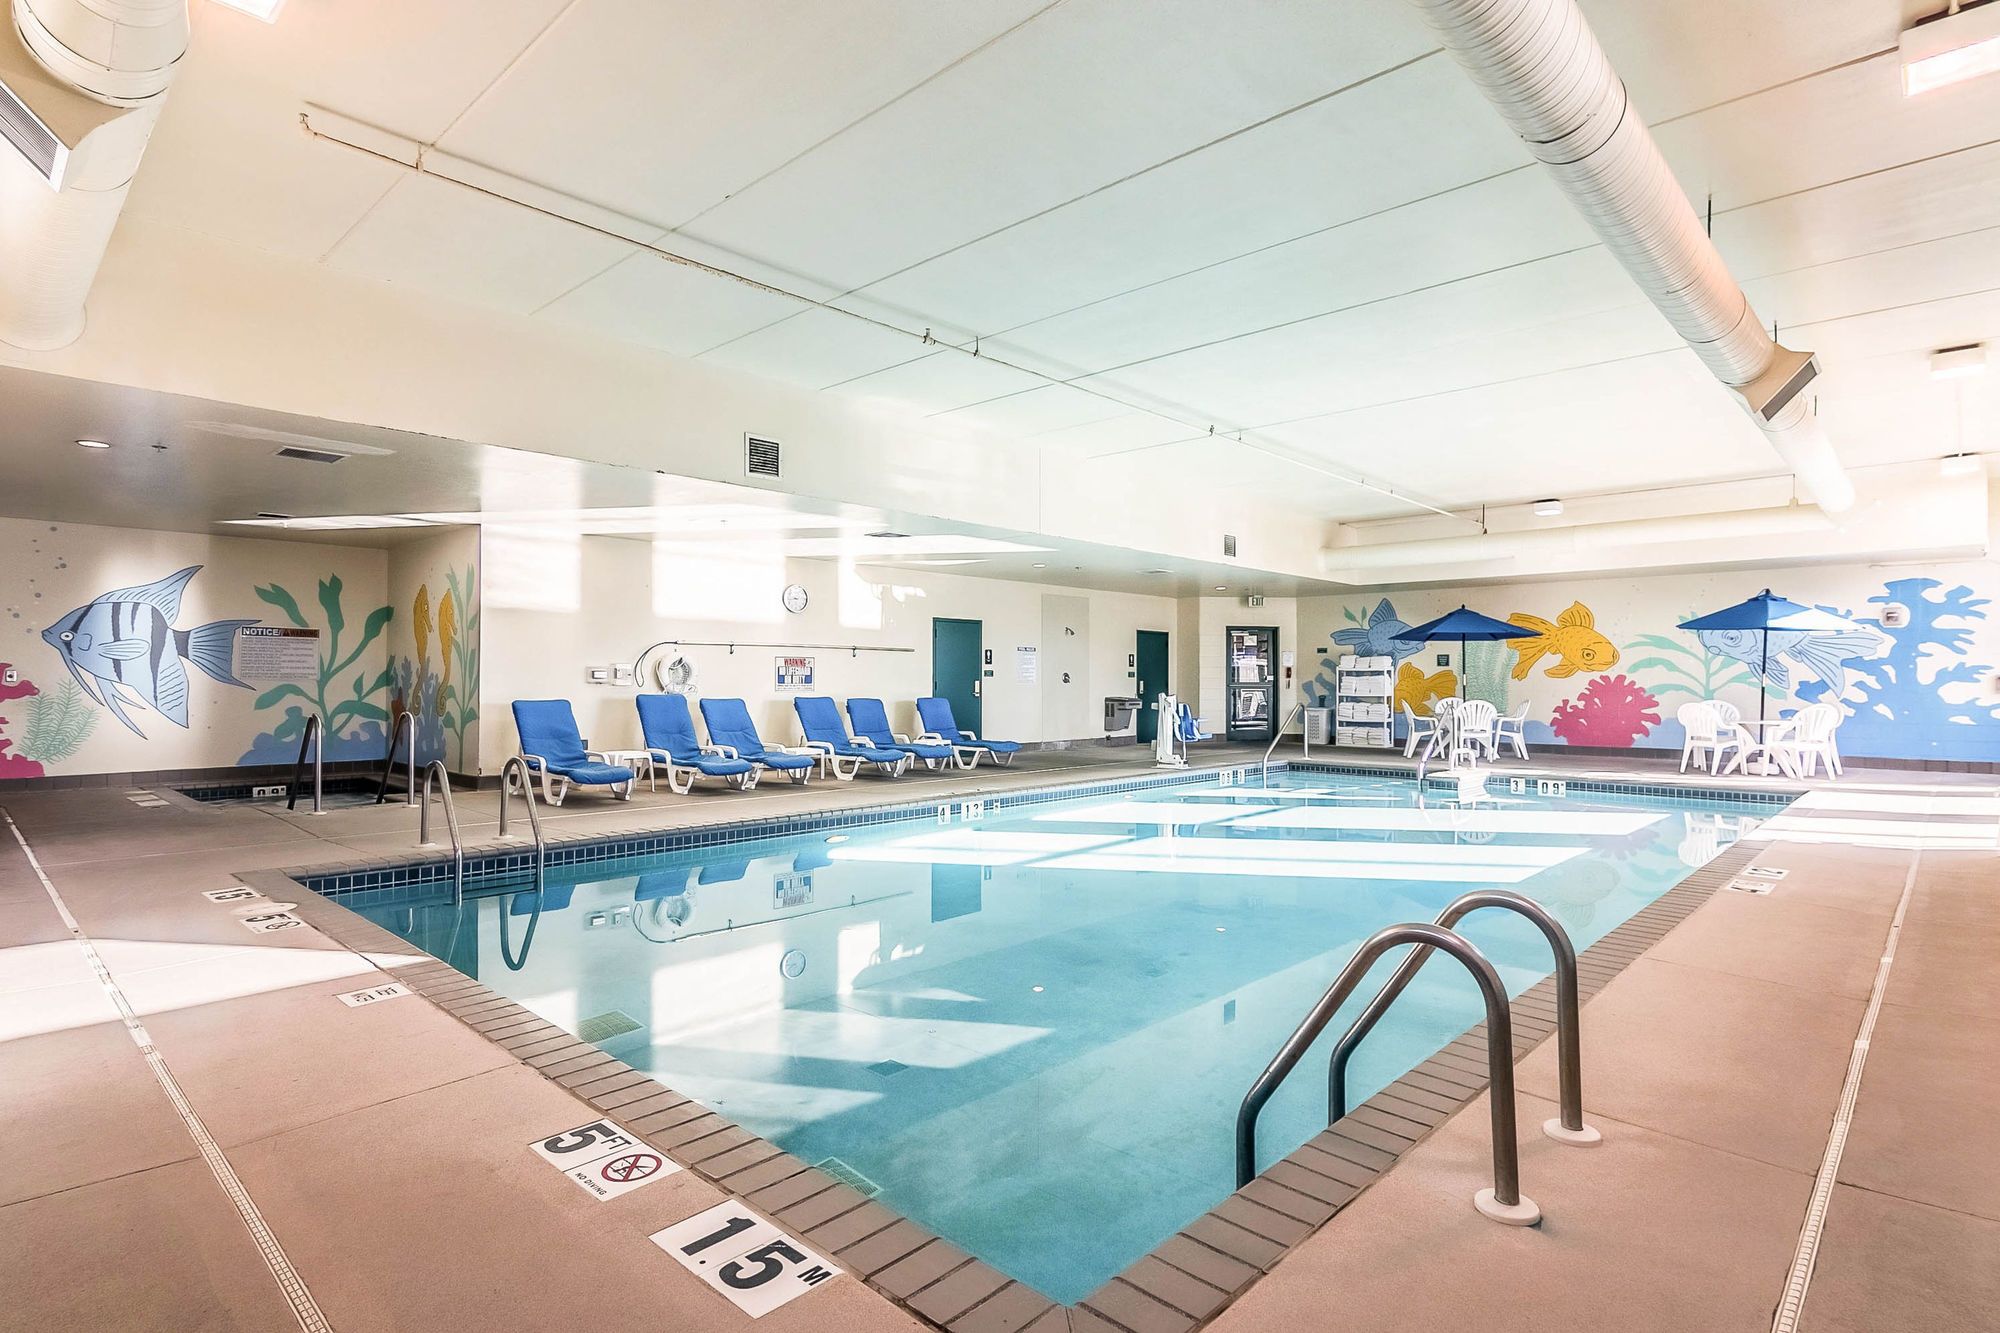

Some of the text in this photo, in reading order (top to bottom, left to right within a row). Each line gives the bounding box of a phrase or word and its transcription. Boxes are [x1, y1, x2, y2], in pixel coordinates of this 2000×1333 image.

[543, 1122, 633, 1154] 5 FT
[584, 1179, 607, 1196] DIVING
[796, 1264, 832, 1287] M
